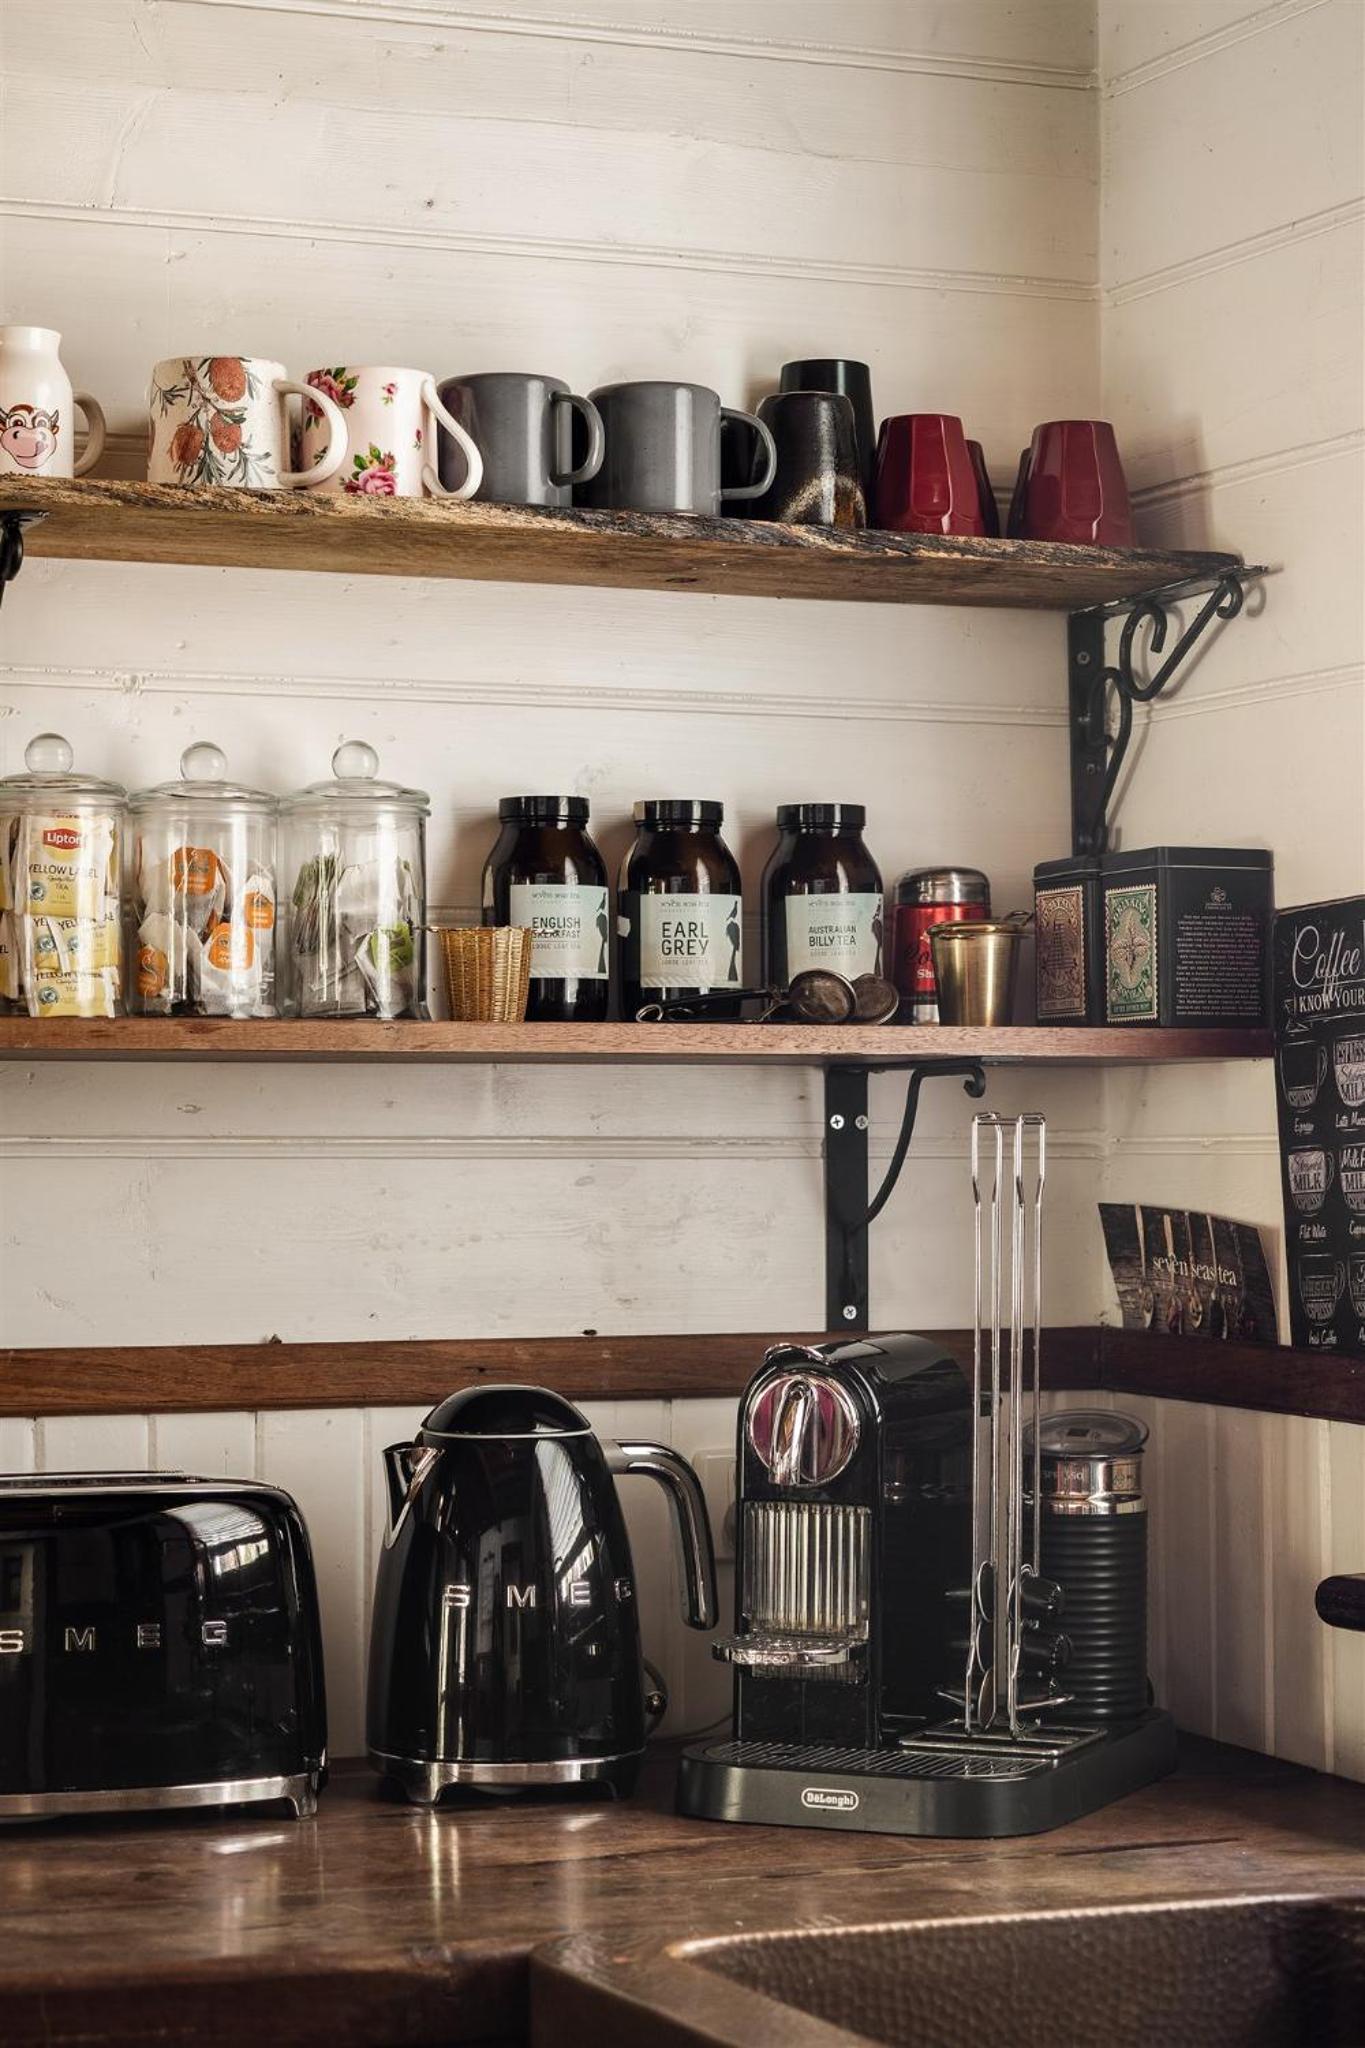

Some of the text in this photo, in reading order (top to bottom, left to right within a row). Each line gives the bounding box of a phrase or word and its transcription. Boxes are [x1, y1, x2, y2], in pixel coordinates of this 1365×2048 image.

[29, 863, 67, 875] YELLOW
[69, 868, 98, 879] LEL
[532, 917, 581, 928] ENGLISH
[662, 922, 709, 938] EARL
[809, 925, 857, 934] AUSTRALIAN
[661, 939, 709, 956] GREY
[809, 936, 857, 947] BILLY TEA
[1292, 926, 1360, 1001] Coffee
[1299, 986, 1365, 1013] KNOW YOUR
[1293, 1173, 1321, 1191] MILK
[1153, 1255, 1237, 1286] seven seas tea
[442, 1577, 632, 1607] SMEG
[0, 1620, 228, 1653] SMEG
